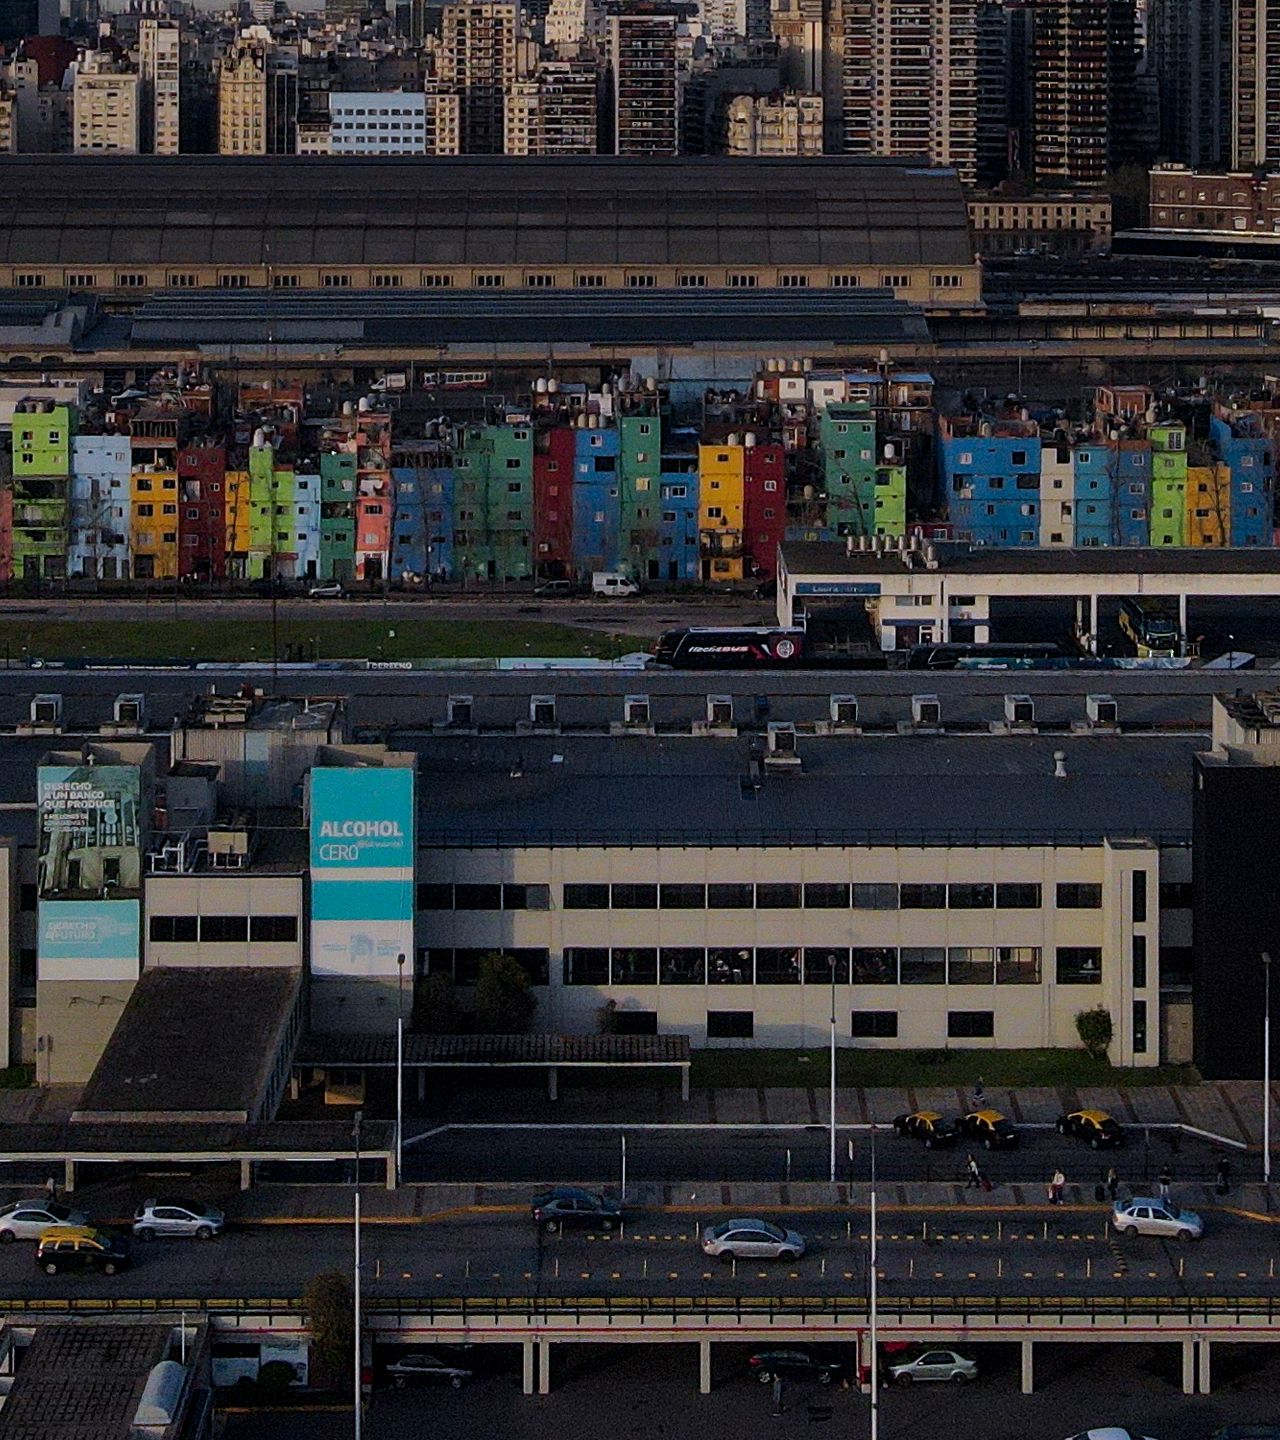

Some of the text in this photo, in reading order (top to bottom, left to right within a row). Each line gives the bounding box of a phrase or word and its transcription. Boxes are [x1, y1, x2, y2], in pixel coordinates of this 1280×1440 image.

[44, 782, 91, 790] DERECHO
[52, 791, 68, 799] UN
[69, 791, 104, 799] BANCO
[44, 800, 115, 810] QUE PRODUCE
[320, 820, 404, 837] ALCOHOL
[319, 844, 359, 861] CERO
